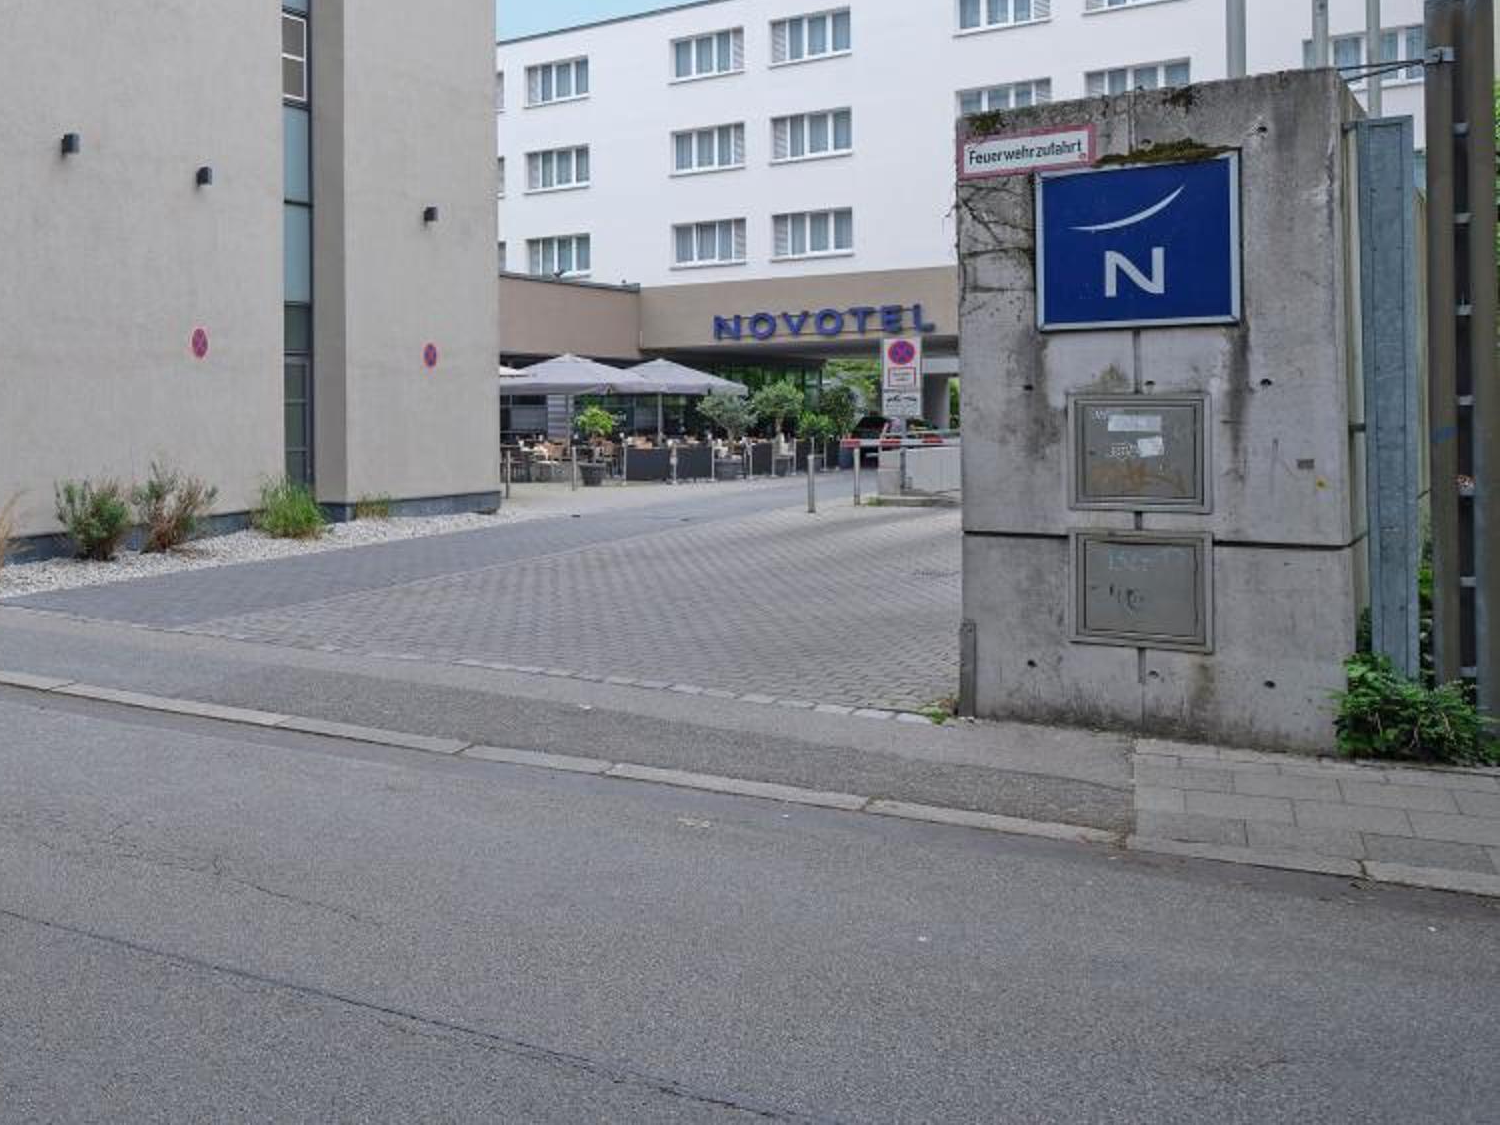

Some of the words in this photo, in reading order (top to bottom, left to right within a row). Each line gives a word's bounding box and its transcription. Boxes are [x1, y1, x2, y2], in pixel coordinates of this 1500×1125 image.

[968, 139, 1082, 166] Feuerwehrzufahrt
[1104, 246, 1165, 297] N
[713, 304, 936, 342] NOVOTEL
